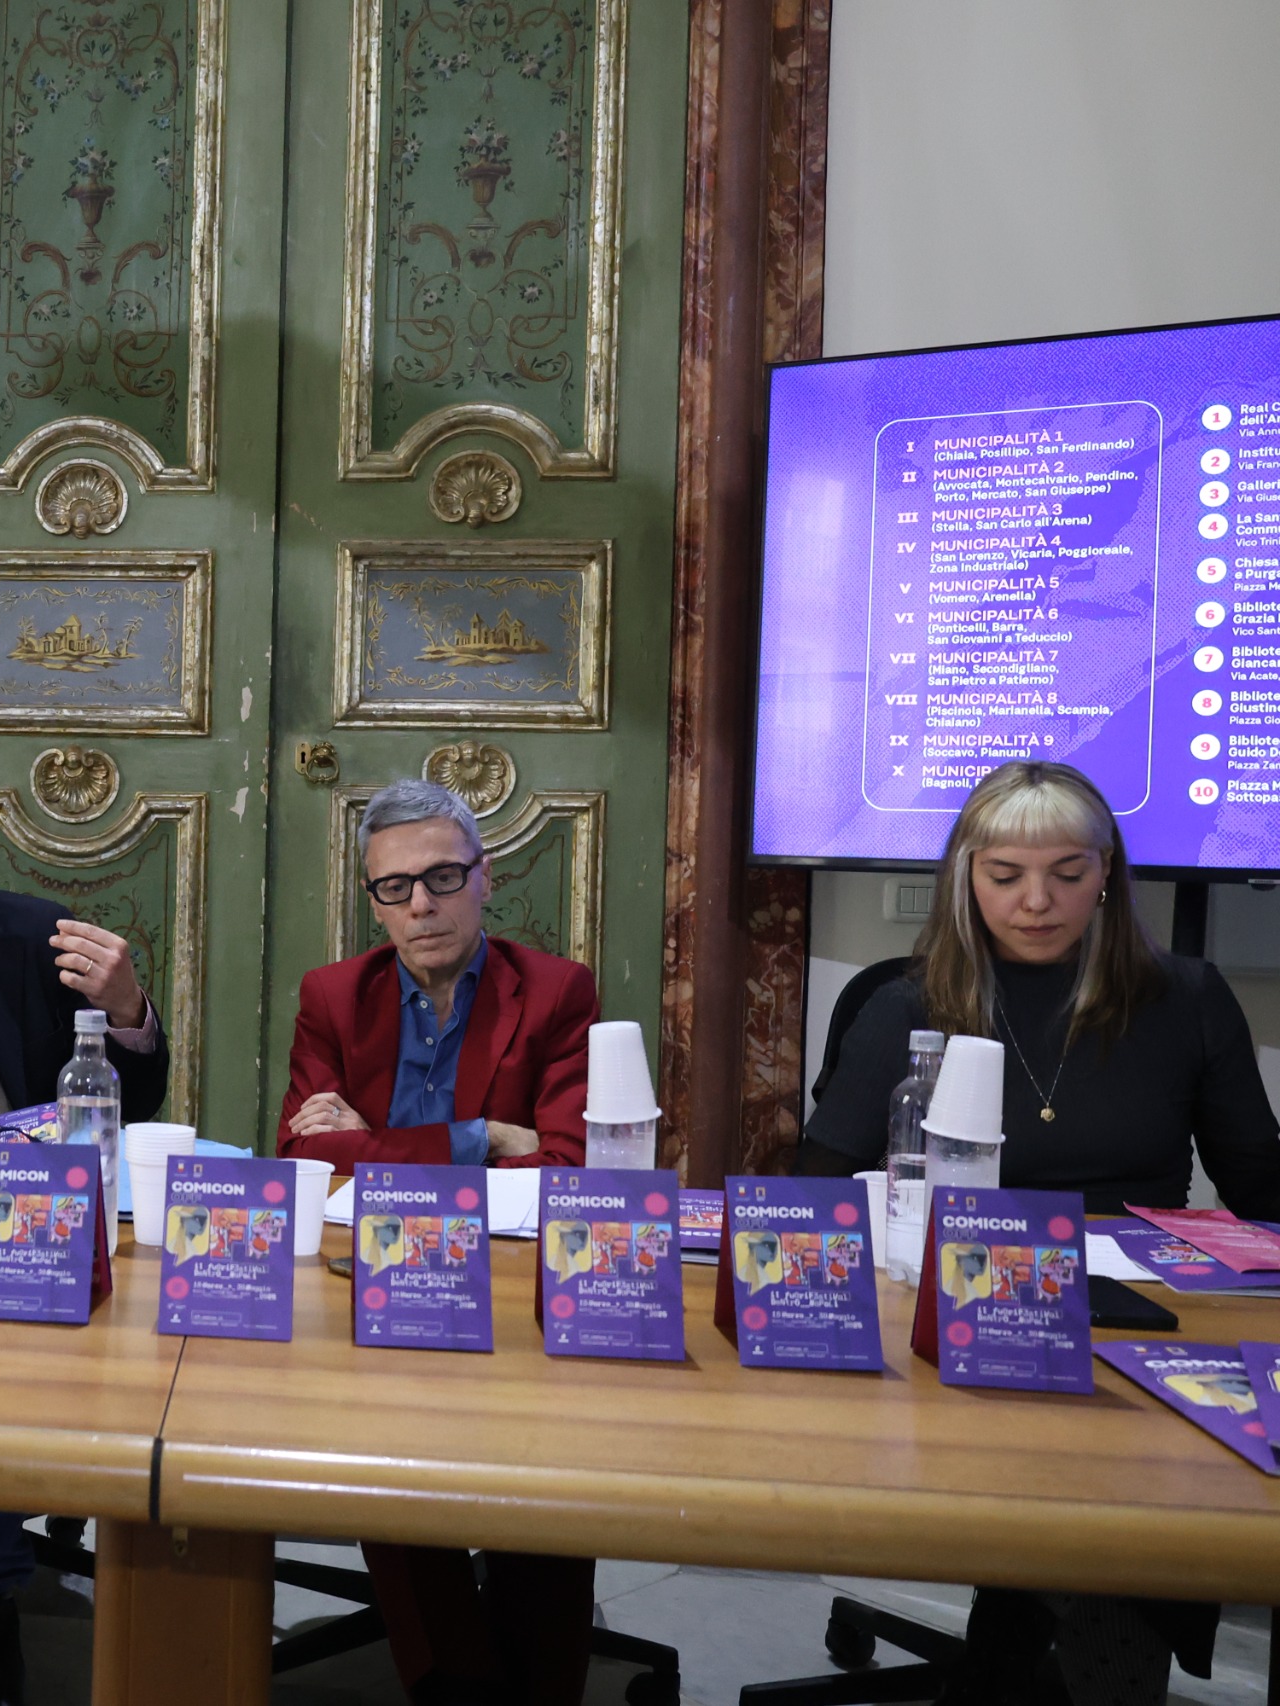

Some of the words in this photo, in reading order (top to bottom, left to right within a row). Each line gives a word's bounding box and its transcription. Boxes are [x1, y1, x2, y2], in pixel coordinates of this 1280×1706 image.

[1240, 402, 1269, 414] Real
[1239, 429, 1255, 437] Via
[906, 442, 915, 453] I
[934, 429, 1051, 451] MUNICIPALITÀ
[1054, 431, 1064, 442] 1
[934, 450, 977, 462] (Chiaia,
[980, 447, 1033, 459] Posillipo,
[1036, 445, 1059, 455] San
[1062, 438, 1135, 453] Ferdinando)
[1239, 446, 1280, 458] Institu
[902, 471, 917, 483] II
[933, 460, 1050, 481] MUNICIPALITÀ
[1053, 461, 1064, 473] 2
[1238, 462, 1254, 470] Via
[933, 479, 993, 492] (Avvocata,
[995, 474, 1083, 488] Montecalvario,
[1086, 470, 1139, 482] Pendino,
[1237, 479, 1280, 491] Galleri
[935, 491, 969, 503] Porto,
[971, 488, 1022, 501] Mercato,
[1025, 486, 1048, 497] San
[1050, 483, 1112, 496] Giuseppe)
[1237, 494, 1253, 503] Via
[897, 512, 919, 524] III
[932, 502, 1049, 522] MUNICIPALITÀ
[1052, 503, 1063, 515] 3
[1236, 514, 1252, 524] La
[1255, 513, 1280, 522] San
[932, 520, 973, 533] (Stella,
[976, 519, 999, 530] San
[1000, 517, 1031, 529] Carlo
[897, 542, 917, 554] IV
[930, 533, 1048, 553] MUNICIPALITÀ
[1050, 535, 1062, 547] 4
[1235, 538, 1258, 547] Vico
[930, 552, 957, 564] (San
[959, 551, 1008, 563] Lorenzo,
[1011, 548, 1056, 560] Vicaria,
[1058, 545, 1134, 558] Poggioreale,
[929, 563, 958, 574] Zona
[961, 560, 1029, 573] Industriale)
[1235, 557, 1279, 568] Chiesa
[1234, 571, 1243, 580] e
[899, 583, 912, 594] V
[929, 574, 1046, 593] MUNICIPALITÀ
[1049, 577, 1060, 589] 5
[1234, 583, 1266, 592] Piazza
[929, 593, 979, 605] (Vomero,
[982, 590, 1036, 602] Arenella)
[1233, 601, 1280, 613] Bibliote
[894, 612, 915, 624] VI
[928, 606, 1045, 623] MUNICIPALITÀ
[1048, 608, 1059, 620] 6
[1233, 613, 1276, 624] Grazia
[927, 622, 990, 635] (Ponticelli,
[992, 622, 1028, 633] Barra,
[1232, 627, 1255, 636] Vico
[1257, 626, 1280, 635] Sant
[927, 634, 949, 645] San
[951, 633, 1003, 644] Giovanni
[1005, 635, 1013, 644] a
[1015, 632, 1073, 644] Teduccio)
[889, 653, 916, 664] VII
[928, 648, 1045, 664] MUNICIPALITÀ
[1048, 650, 1059, 662] 7
[1232, 645, 1280, 657] Bibliote
[928, 664, 969, 676] (Miano,
[972, 663, 1059, 675] Secondigliano,
[928, 676, 949, 686] San
[951, 675, 986, 686] Pietro
[988, 677, 997, 685] a
[1231, 672, 1247, 681] Via
[885, 694, 918, 706] VIII
[927, 690, 1043, 706] MUNICIPALITÀ
[1046, 692, 1058, 704] 8
[1230, 690, 1280, 702] Bibliote
[926, 706, 986, 718] (Piscinola,
[988, 706, 1054, 717] Marianella,
[1057, 705, 1114, 717] Scampia,
[926, 717, 981, 729] Chiaiano)
[1229, 716, 1262, 725] Piazza
[1264, 715, 1280, 725] Gio
[889, 735, 909, 746] IX
[923, 732, 1040, 747] MUNICIPALITÀ
[1043, 734, 1054, 746] 9
[1229, 735, 1280, 746] Bibliote
[923, 747, 978, 759] (Soccavo,
[980, 746, 1031, 758] Pianura)
[1228, 747, 1267, 757] Guido
[892, 765, 905, 777] X
[922, 765, 998, 777] MUNICIP
[1227, 761, 1260, 770] Piazza
[1263, 760, 1280, 769] Zan
[922, 778, 973, 789] (Bagnoli,
[1227, 780, 1269, 791] Piazza
[171, 1181, 245, 1196] COMICON
[361, 1190, 438, 1204] COMICON
[547, 1194, 626, 1209] COMICON
[734, 1205, 814, 1219] COMICON
[942, 1215, 1027, 1232] COMICON
